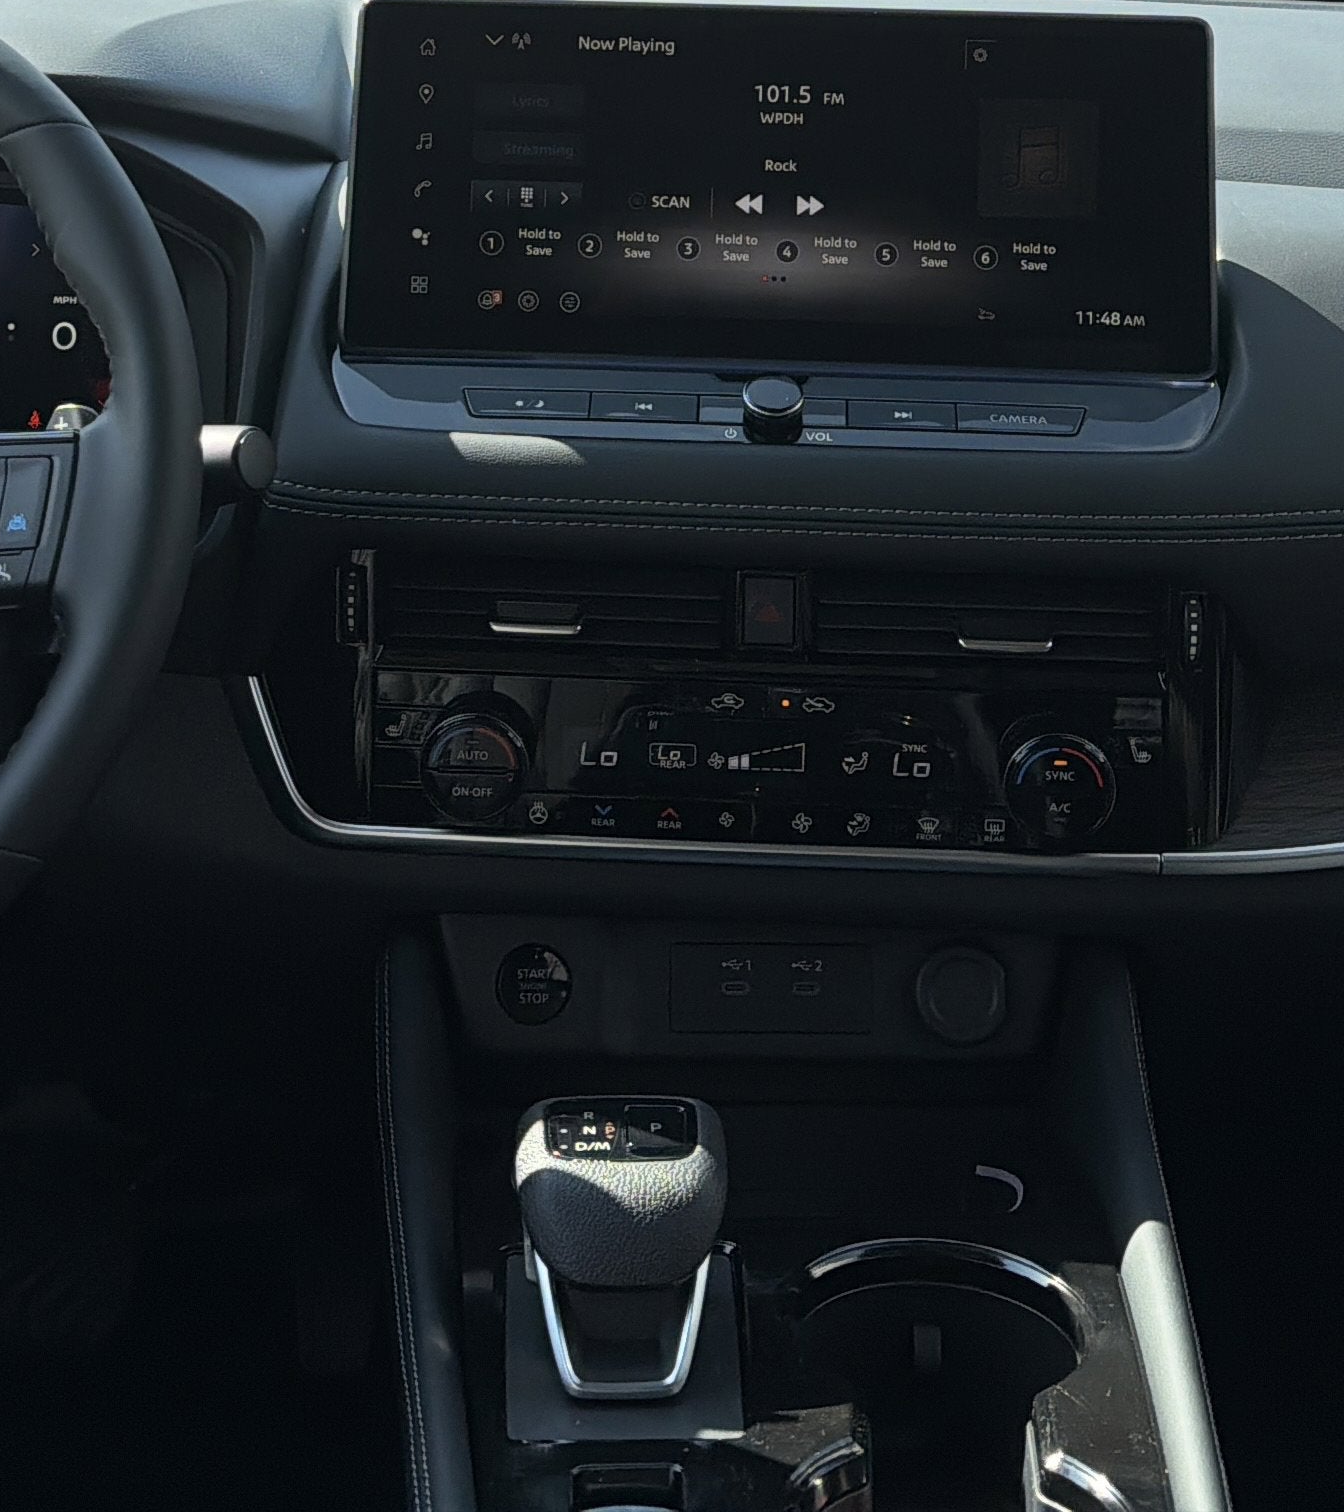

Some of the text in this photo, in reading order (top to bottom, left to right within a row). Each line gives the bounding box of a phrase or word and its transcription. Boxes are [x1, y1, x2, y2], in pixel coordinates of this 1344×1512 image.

[578, 36, 675, 56] Now Playing
[755, 85, 844, 105] 101.5 FM
[512, 95, 549, 109] Lyrics
[760, 112, 803, 124] WPDH
[504, 143, 574, 159] Streaming
[765, 160, 797, 172] Rock
[651, 196, 690, 208] SCAN
[519, 228, 561, 240] Hold to
[617, 231, 659, 243] Hold to
[487, 238, 494, 249] 1
[715, 234, 758, 246] Hold to
[814, 237, 857, 248] Hold to
[913, 239, 957, 251] Hold to
[526, 245, 552, 256] Save
[585, 240, 594, 252] 2
[684, 243, 692, 255] 3
[782, 246, 792, 257] 4
[1013, 243, 1056, 255] Hold to
[624, 248, 650, 259] Save
[723, 251, 750, 262] Save
[882, 249, 891, 261] 5
[981, 252, 990, 264] 6
[822, 254, 848, 265] Save
[921, 257, 948, 268] Save
[1021, 260, 1047, 271] Save
[53, 296, 77, 304] MPH
[1075, 311, 1145, 327] 11:48 AM
[52, 322, 76, 350] 0
[990, 413, 1047, 425] CAMERA
[806, 432, 833, 441] VOL
[902, 744, 927, 753] SYNC
[457, 750, 488, 761] AUTO
[660, 760, 685, 769] REAR
[1045, 772, 1075, 781] SYNC
[1049, 803, 1070, 814] A/C
[591, 818, 615, 826] REAR
[658, 820, 681, 829] REAR
[815, 959, 822, 971] 2
[517, 968, 551, 979] START
[519, 992, 549, 1003] STOP
[582, 1126, 596, 1135] N
[651, 1123, 661, 1132] P
[575, 1142, 610, 1151] D/M
